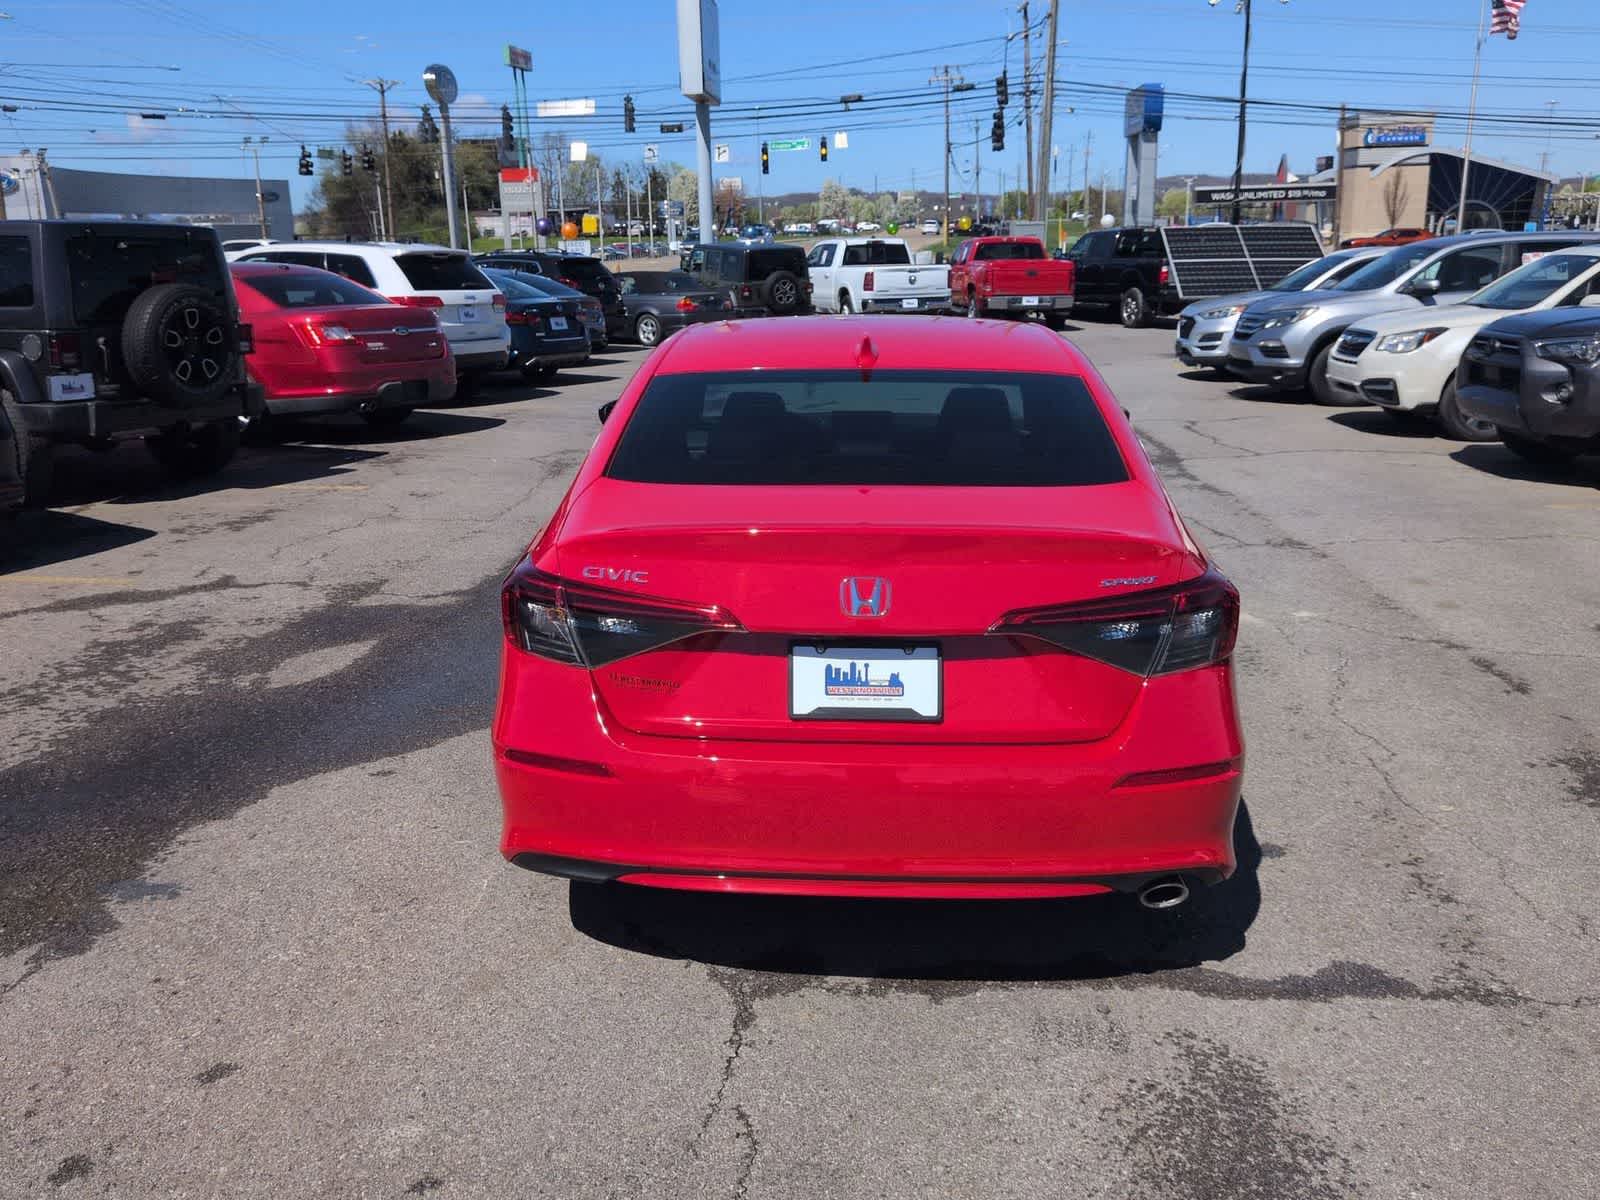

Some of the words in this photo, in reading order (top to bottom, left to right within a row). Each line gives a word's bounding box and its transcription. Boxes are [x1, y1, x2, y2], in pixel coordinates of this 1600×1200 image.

[1239, 190, 1286, 200] UNLIMITED
[583, 566, 649, 583] CIVIC
[1101, 576, 1157, 586] SPORT
